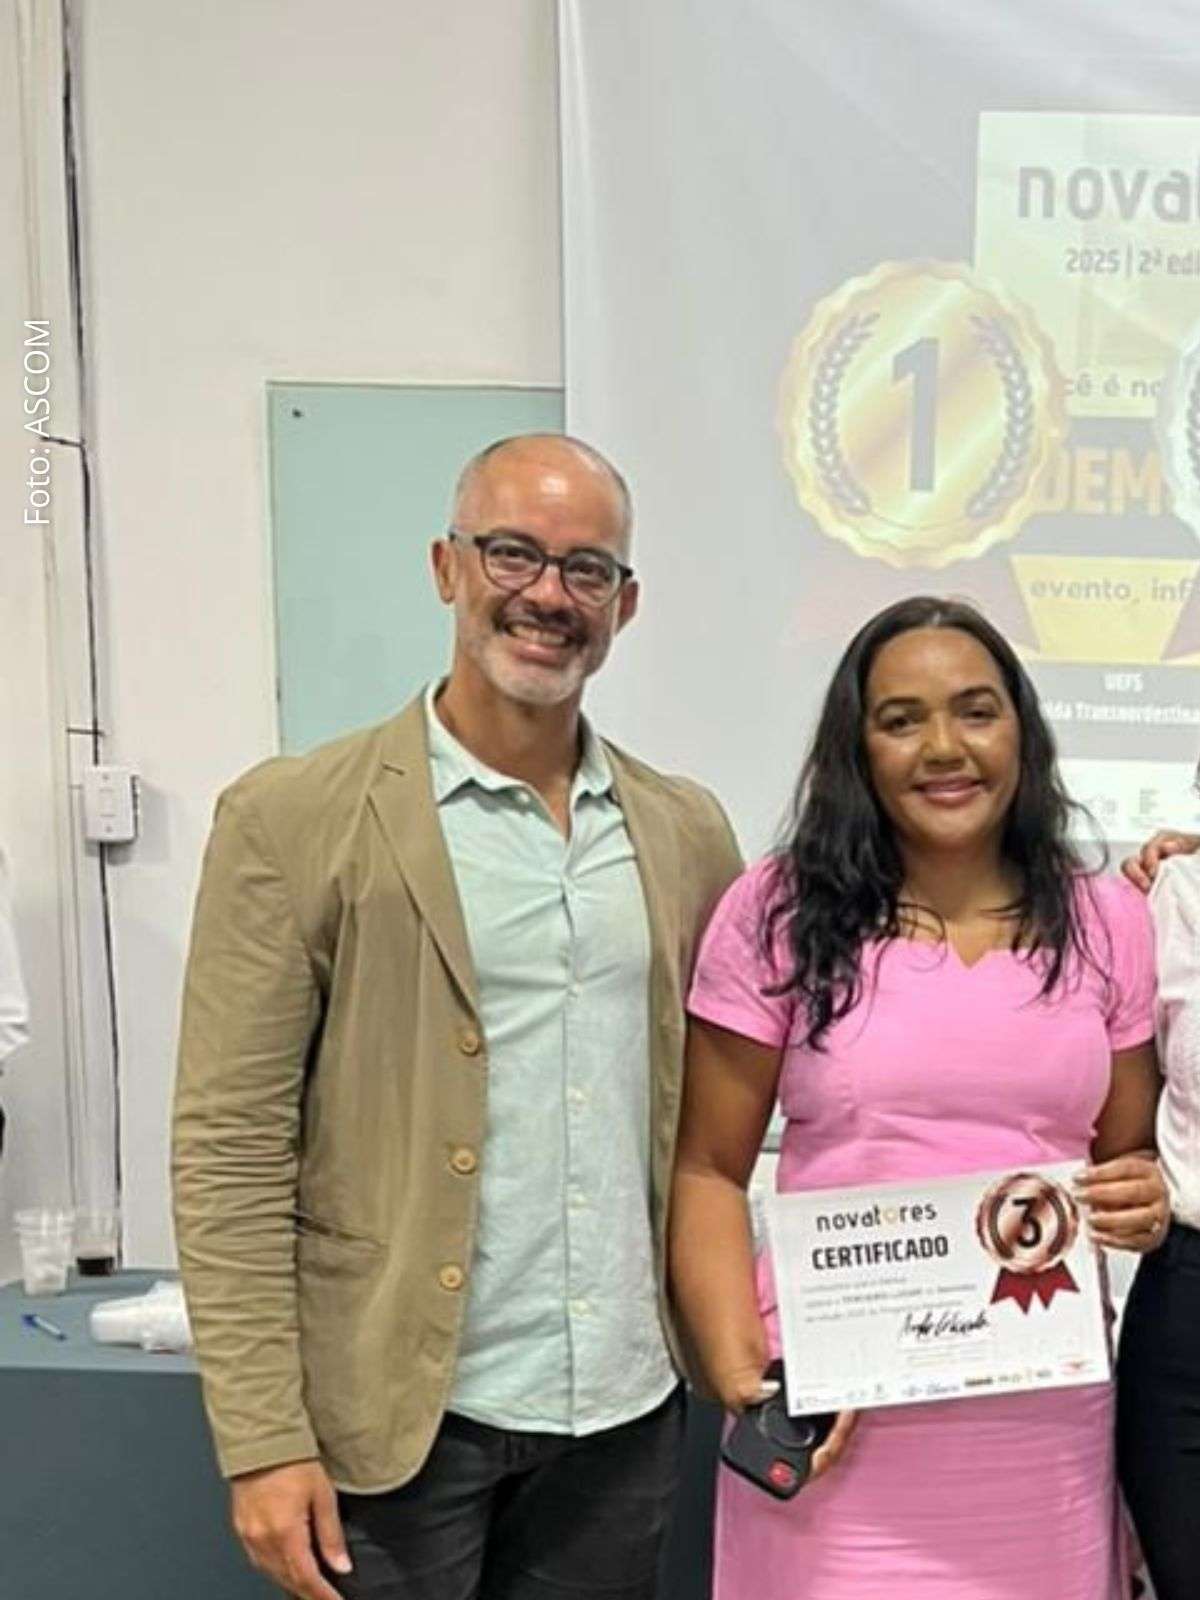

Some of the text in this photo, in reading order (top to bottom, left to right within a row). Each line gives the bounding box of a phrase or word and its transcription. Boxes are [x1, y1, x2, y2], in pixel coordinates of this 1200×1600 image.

[1065, 247, 1121, 274] 2025
[893, 337, 938, 491] 1
[817, 1202, 938, 1233] novatores
[1012, 1198, 1042, 1248] 3
[811, 1235, 949, 1271] CERTIFICADO
